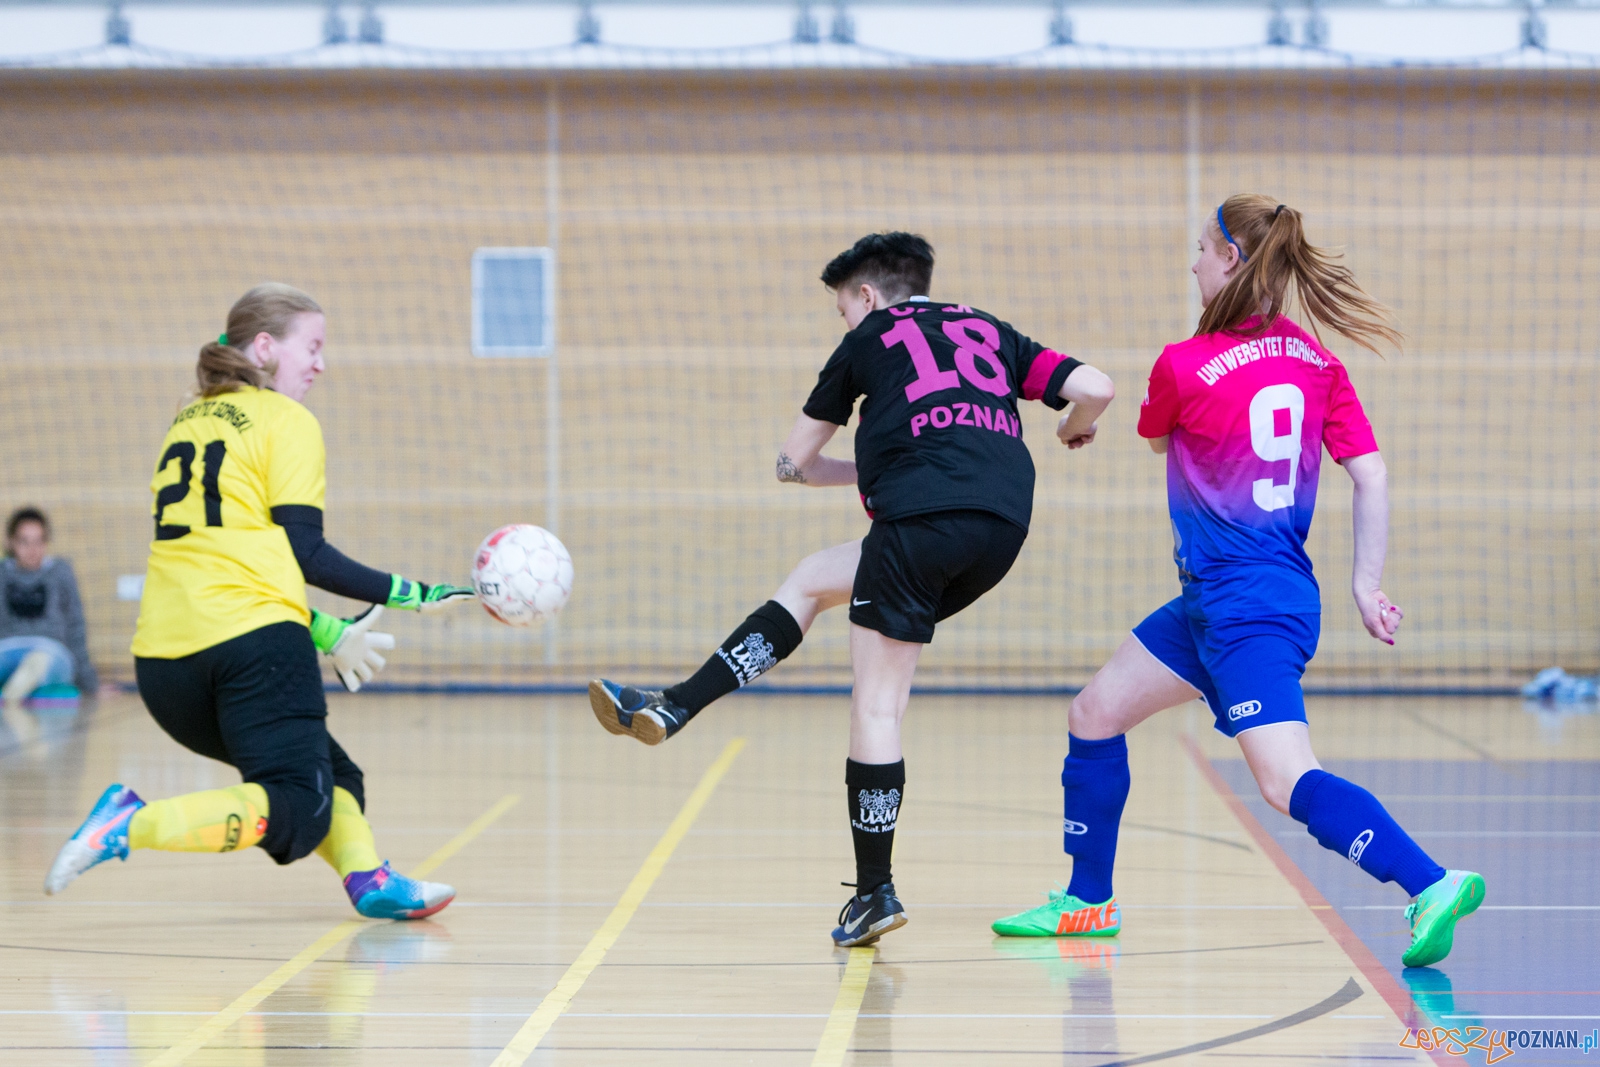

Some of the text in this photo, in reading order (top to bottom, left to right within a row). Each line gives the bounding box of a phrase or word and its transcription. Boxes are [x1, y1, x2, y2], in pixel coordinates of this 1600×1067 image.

[880, 317, 1011, 403] 18
[1196, 336, 1283, 386] UNIWERSYTET
[1249, 383, 1305, 512] 9
[153, 439, 227, 541] 21
[731, 642, 761, 682] UAM
[860, 807, 898, 824] UAM
[1055, 897, 1118, 935] NIKE
